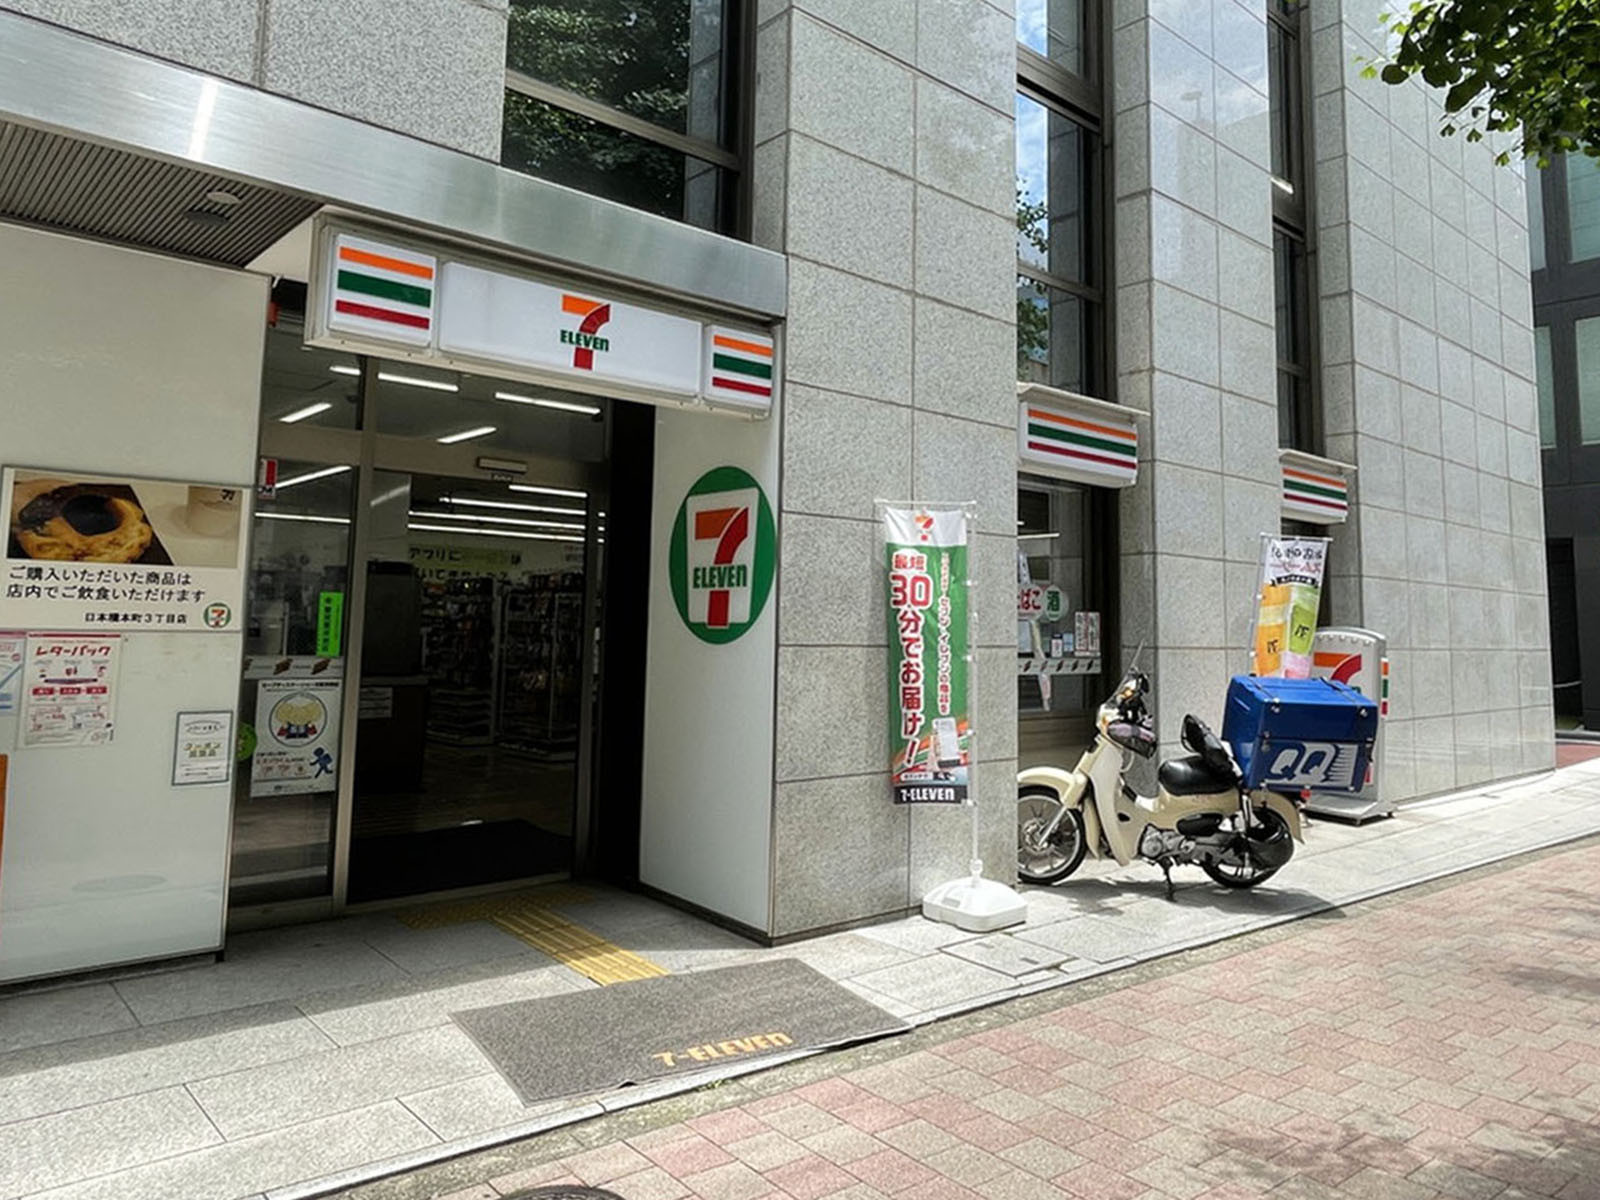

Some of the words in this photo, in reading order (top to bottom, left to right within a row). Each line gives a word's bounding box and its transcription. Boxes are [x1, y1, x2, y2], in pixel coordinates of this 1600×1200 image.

[9, 566, 192, 586] ご購入いただいた商品は
[6, 584, 205, 603] 店内でご飲食いただけます
